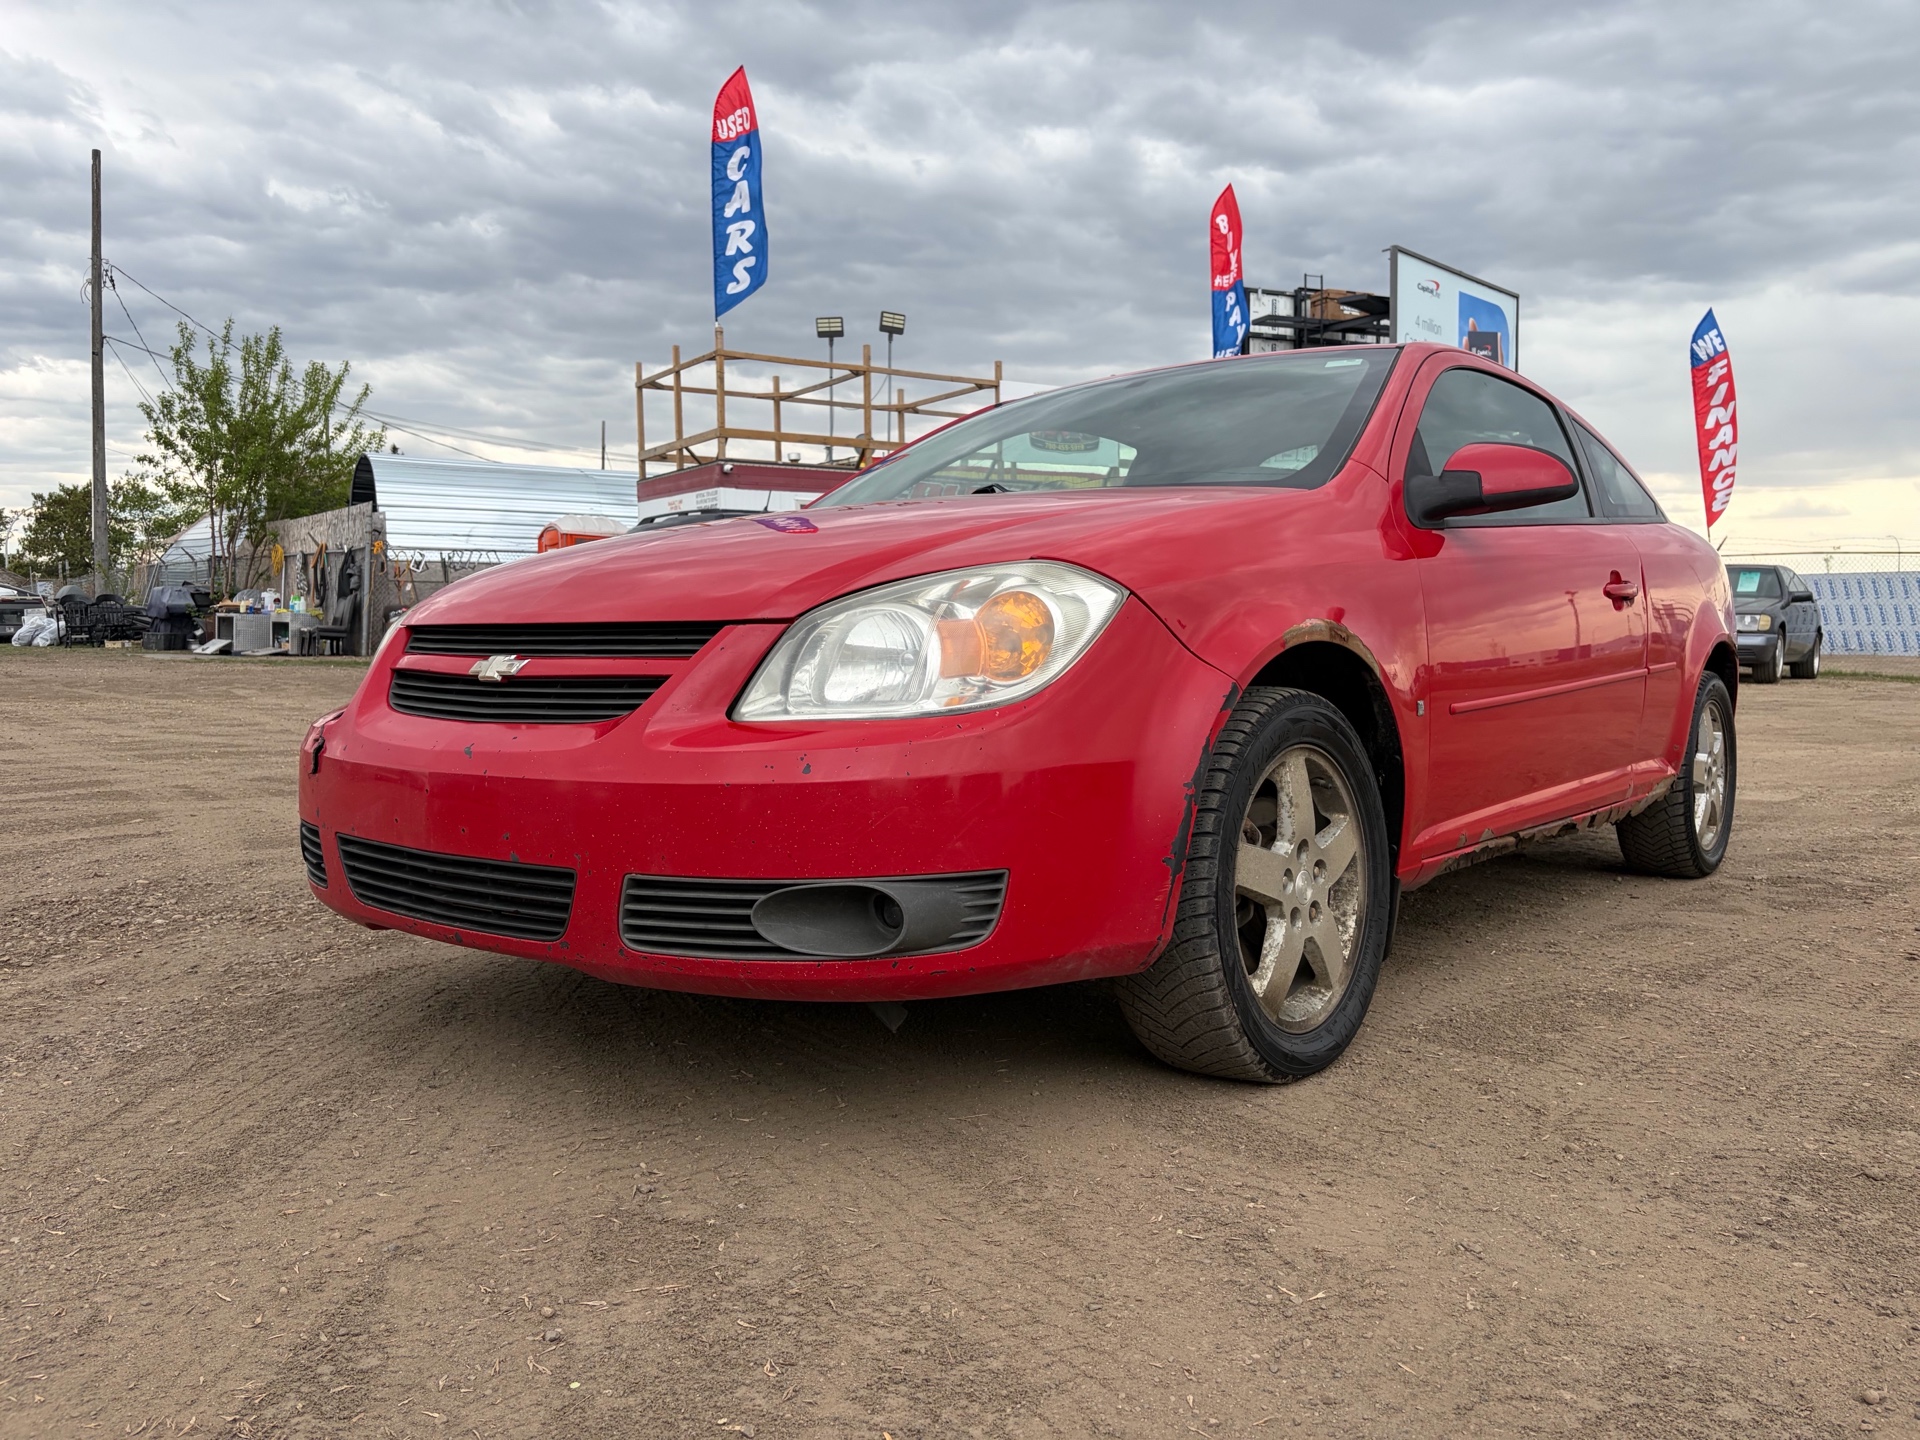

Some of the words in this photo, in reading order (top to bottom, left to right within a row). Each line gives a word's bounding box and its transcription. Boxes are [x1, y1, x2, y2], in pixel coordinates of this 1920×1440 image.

[716, 106, 750, 140] USED
[723, 145, 756, 295] CARS
[1215, 214, 1238, 271] BUY
[1225, 292, 1246, 345] PAY
[1415, 315, 1420, 328] 4
[1422, 318, 1441, 336] million
[1692, 328, 1725, 361] WE
[1704, 358, 1738, 513] FINANCE
